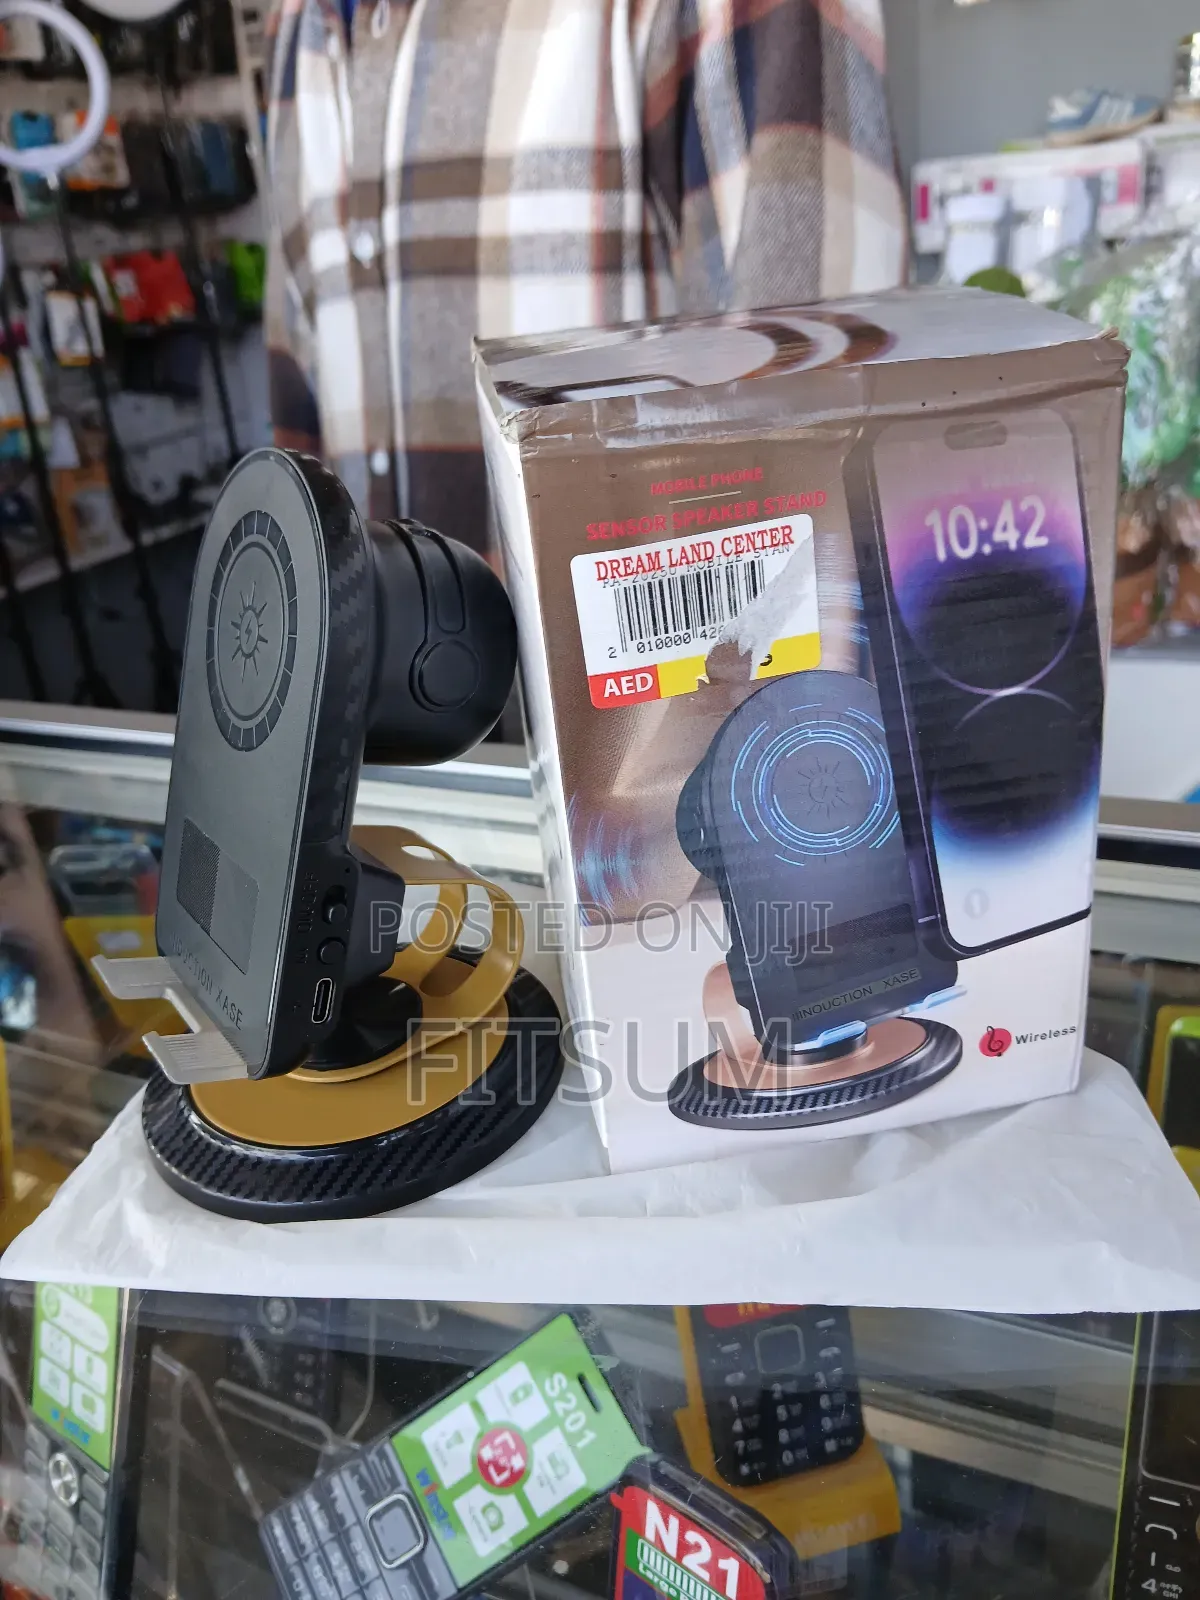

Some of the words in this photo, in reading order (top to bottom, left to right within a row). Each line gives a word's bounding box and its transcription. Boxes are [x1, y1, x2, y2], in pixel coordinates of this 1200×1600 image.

[651, 474, 707, 496] MOBILE
[711, 467, 763, 487] PHONE
[586, 514, 667, 541] SENSOR
[672, 500, 758, 530] SPEAKER
[764, 490, 827, 516] STAND
[924, 495, 1049, 562] 10:42
[595, 550, 663, 581] DREAM
[668, 541, 715, 568] LAND
[720, 525, 794, 556] CENTER
[687, 553, 743, 573] MOBILE
[608, 646, 617, 658] 2
[603, 672, 654, 698] AED
[882, 967, 920, 989] XASE
[215, 985, 244, 1031] XASE
[1015, 1024, 1078, 1045] Wireless
[545, 1372, 596, 1449] S201
[644, 1498, 740, 1600] N21
[1141, 1578, 1158, 1594] 4
